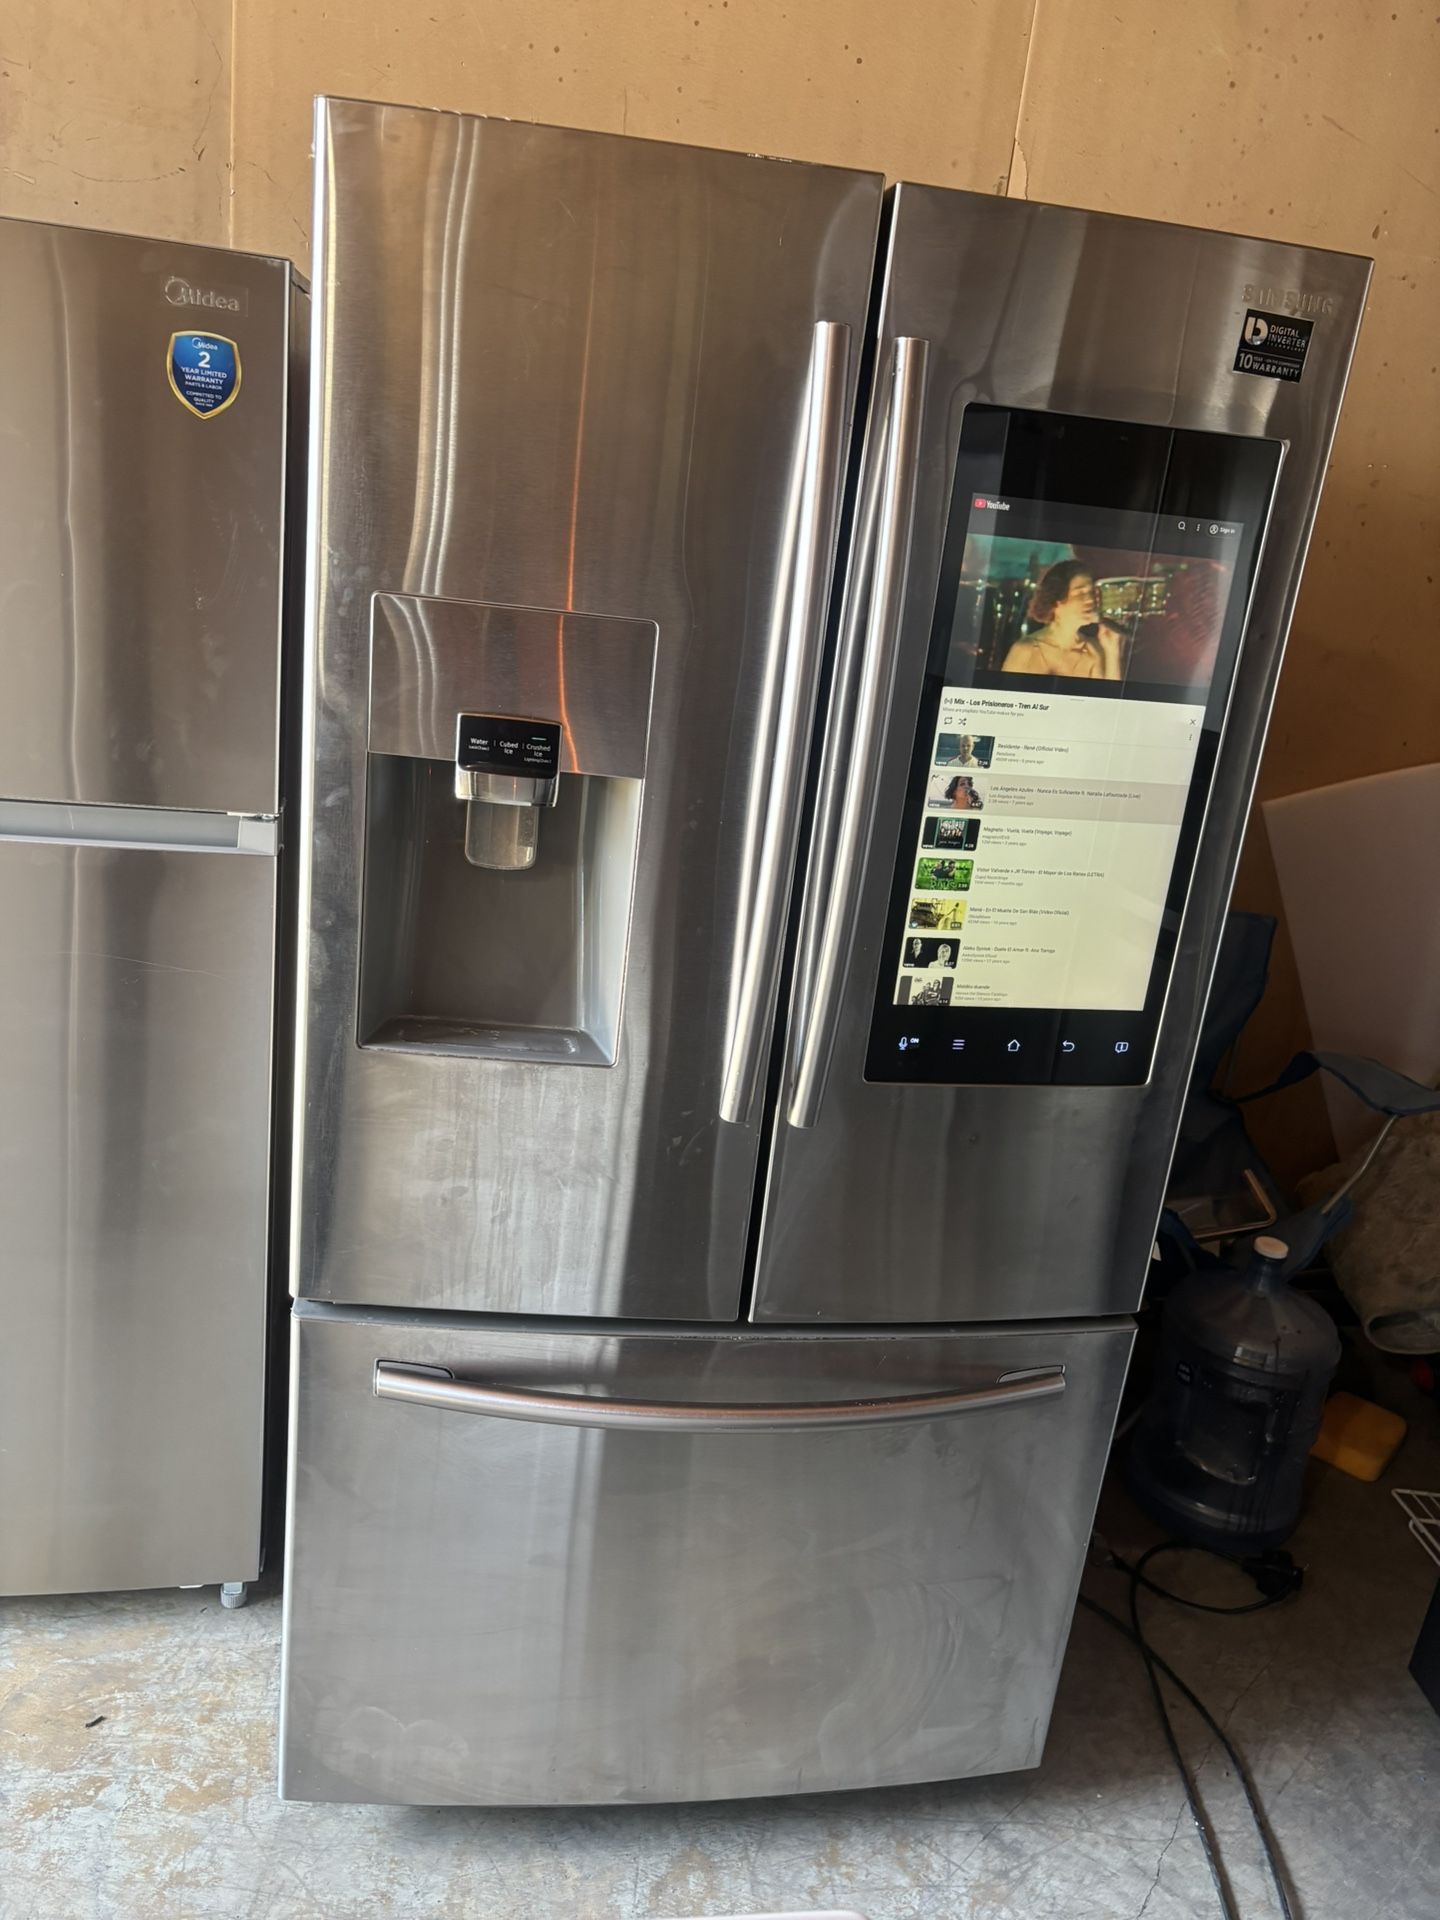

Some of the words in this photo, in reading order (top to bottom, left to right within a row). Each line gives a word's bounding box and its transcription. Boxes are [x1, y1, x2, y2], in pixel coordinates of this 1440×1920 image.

[165, 276, 240, 311] Midea
[1270, 325, 1299, 338] DIGITAL
[192, 337, 218, 351] Midea
[1268, 333, 1305, 348] INVERTER
[198, 351, 211, 368] 2
[1239, 352, 1253, 369] 10
[201, 369, 227, 378] LIMITED
[1252, 362, 1300, 377] WARRANTY
[184, 374, 224, 384] WARRANTY
[987, 500, 1010, 510] YouTube
[981, 700, 1014, 708] Prisioneros
[470, 737, 488, 745] Water
[499, 740, 519, 749] Cubed
[526, 744, 551, 752] Crushed
